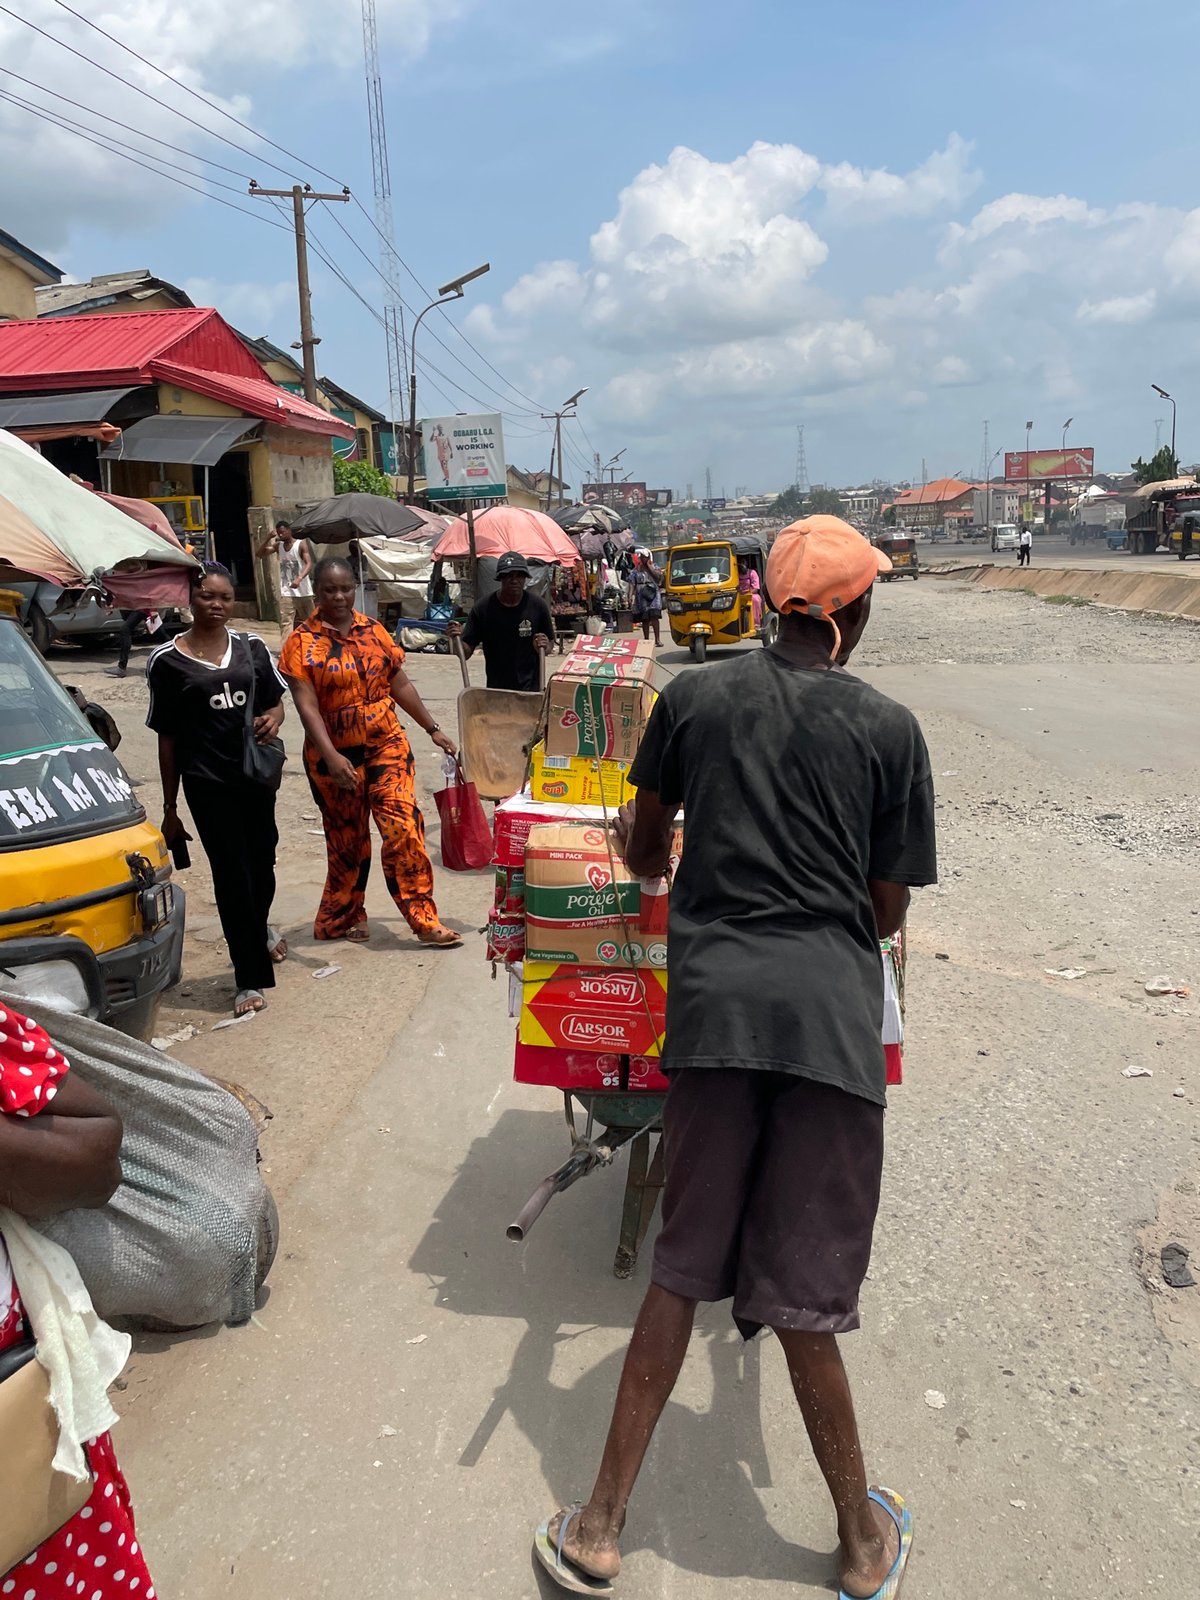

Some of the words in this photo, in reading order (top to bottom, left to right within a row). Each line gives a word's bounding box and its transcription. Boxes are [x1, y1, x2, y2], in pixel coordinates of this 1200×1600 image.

[456, 443, 494, 451] WORKING
[210, 682, 247, 709] alo
[0, 786, 58, 829] EBI
[52, 772, 98, 811] NA
[588, 906, 604, 916] Oil
[580, 978, 638, 1002] LARSOR
[568, 1017, 625, 1039] LARSOR
